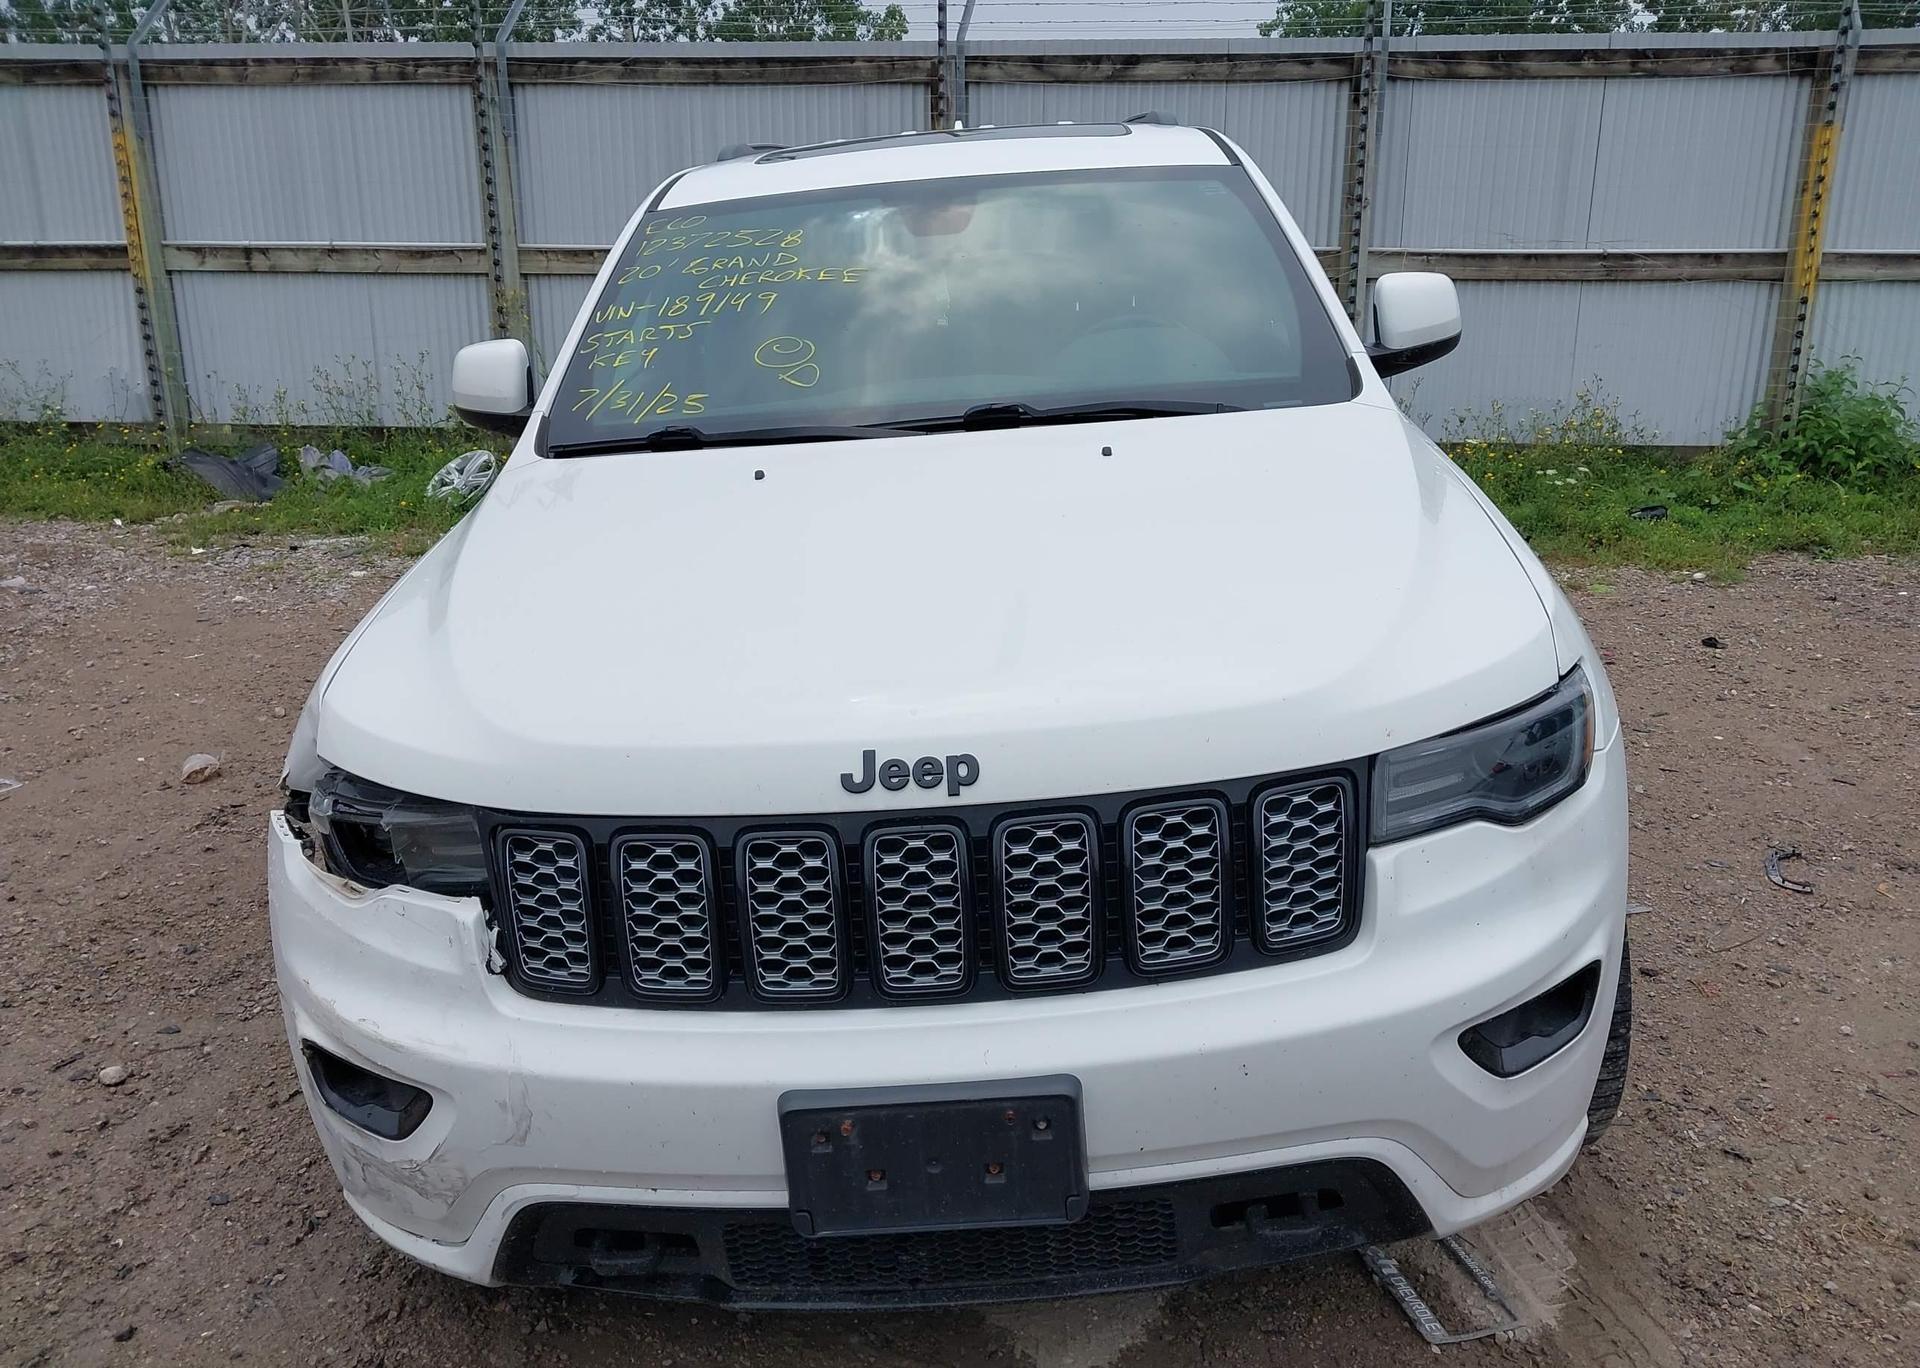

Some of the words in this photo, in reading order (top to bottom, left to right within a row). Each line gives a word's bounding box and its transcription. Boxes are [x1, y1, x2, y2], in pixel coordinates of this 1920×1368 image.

[646, 215, 707, 235] ECO
[636, 229, 803, 256] 12372528
[682, 252, 798, 275] GRAND
[698, 267, 869, 289] CHEROKEE
[580, 320, 711, 353] STARTS
[588, 347, 658, 369] KEY
[571, 379, 709, 424] 7/31/25
[840, 749, 980, 797] Jeep
[1389, 1275, 1444, 1337] CHEVROLET
